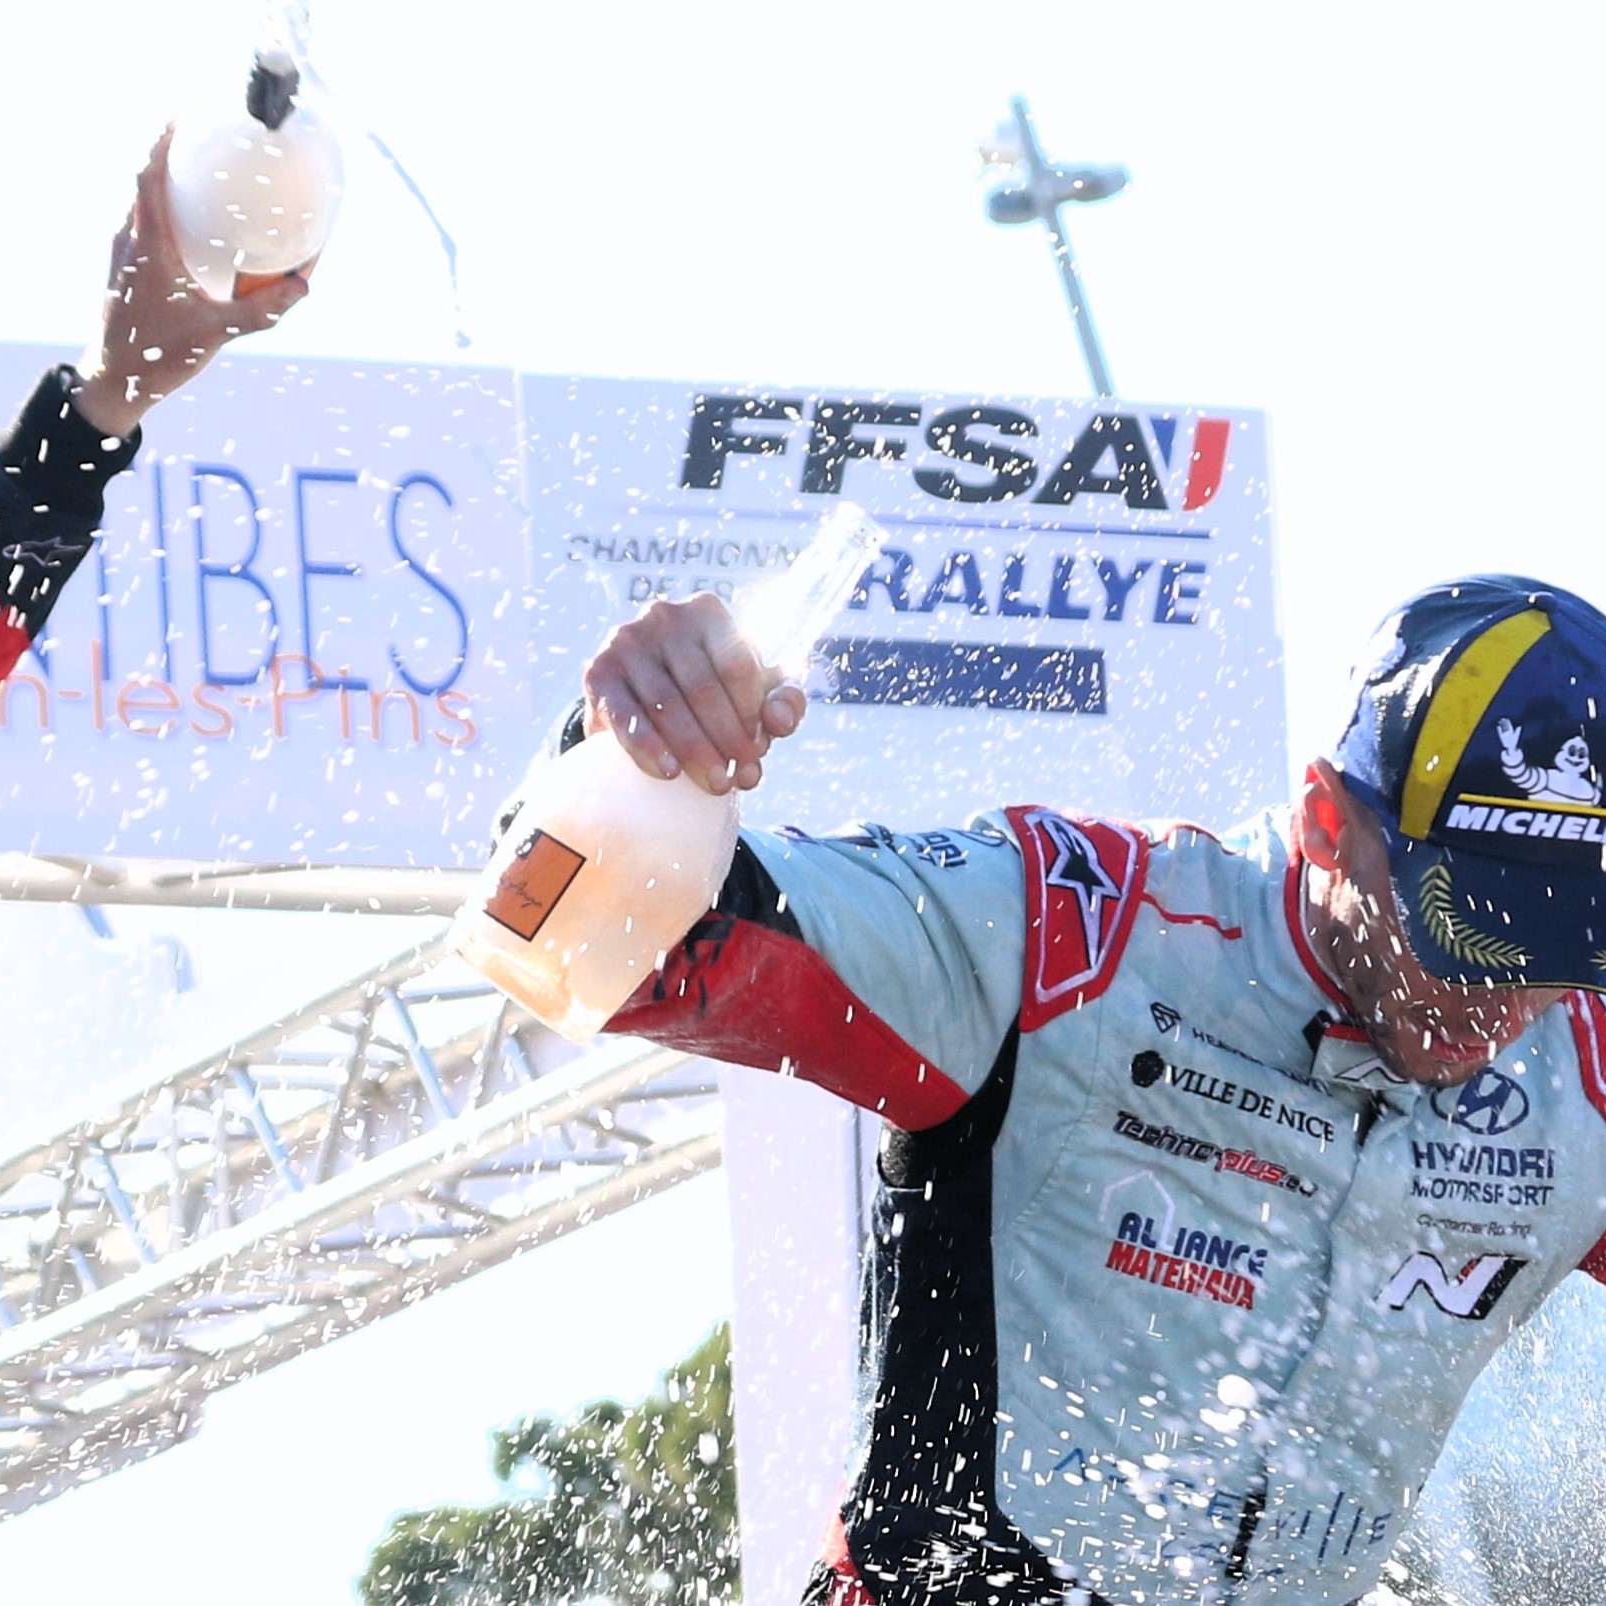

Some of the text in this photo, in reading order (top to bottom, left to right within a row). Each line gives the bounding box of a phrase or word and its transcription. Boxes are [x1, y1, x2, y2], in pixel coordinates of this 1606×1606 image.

[679, 393, 1170, 512] FFSA
[567, 535, 802, 569] CHAMPIONN
[847, 545, 1207, 626] RALLYE
[1170, 1065, 1237, 1105] VILLE
[1237, 1088, 1276, 1120] DE
[1276, 1103, 1336, 1143] NICE
[1410, 1140, 1556, 1180] HYUNDAI
